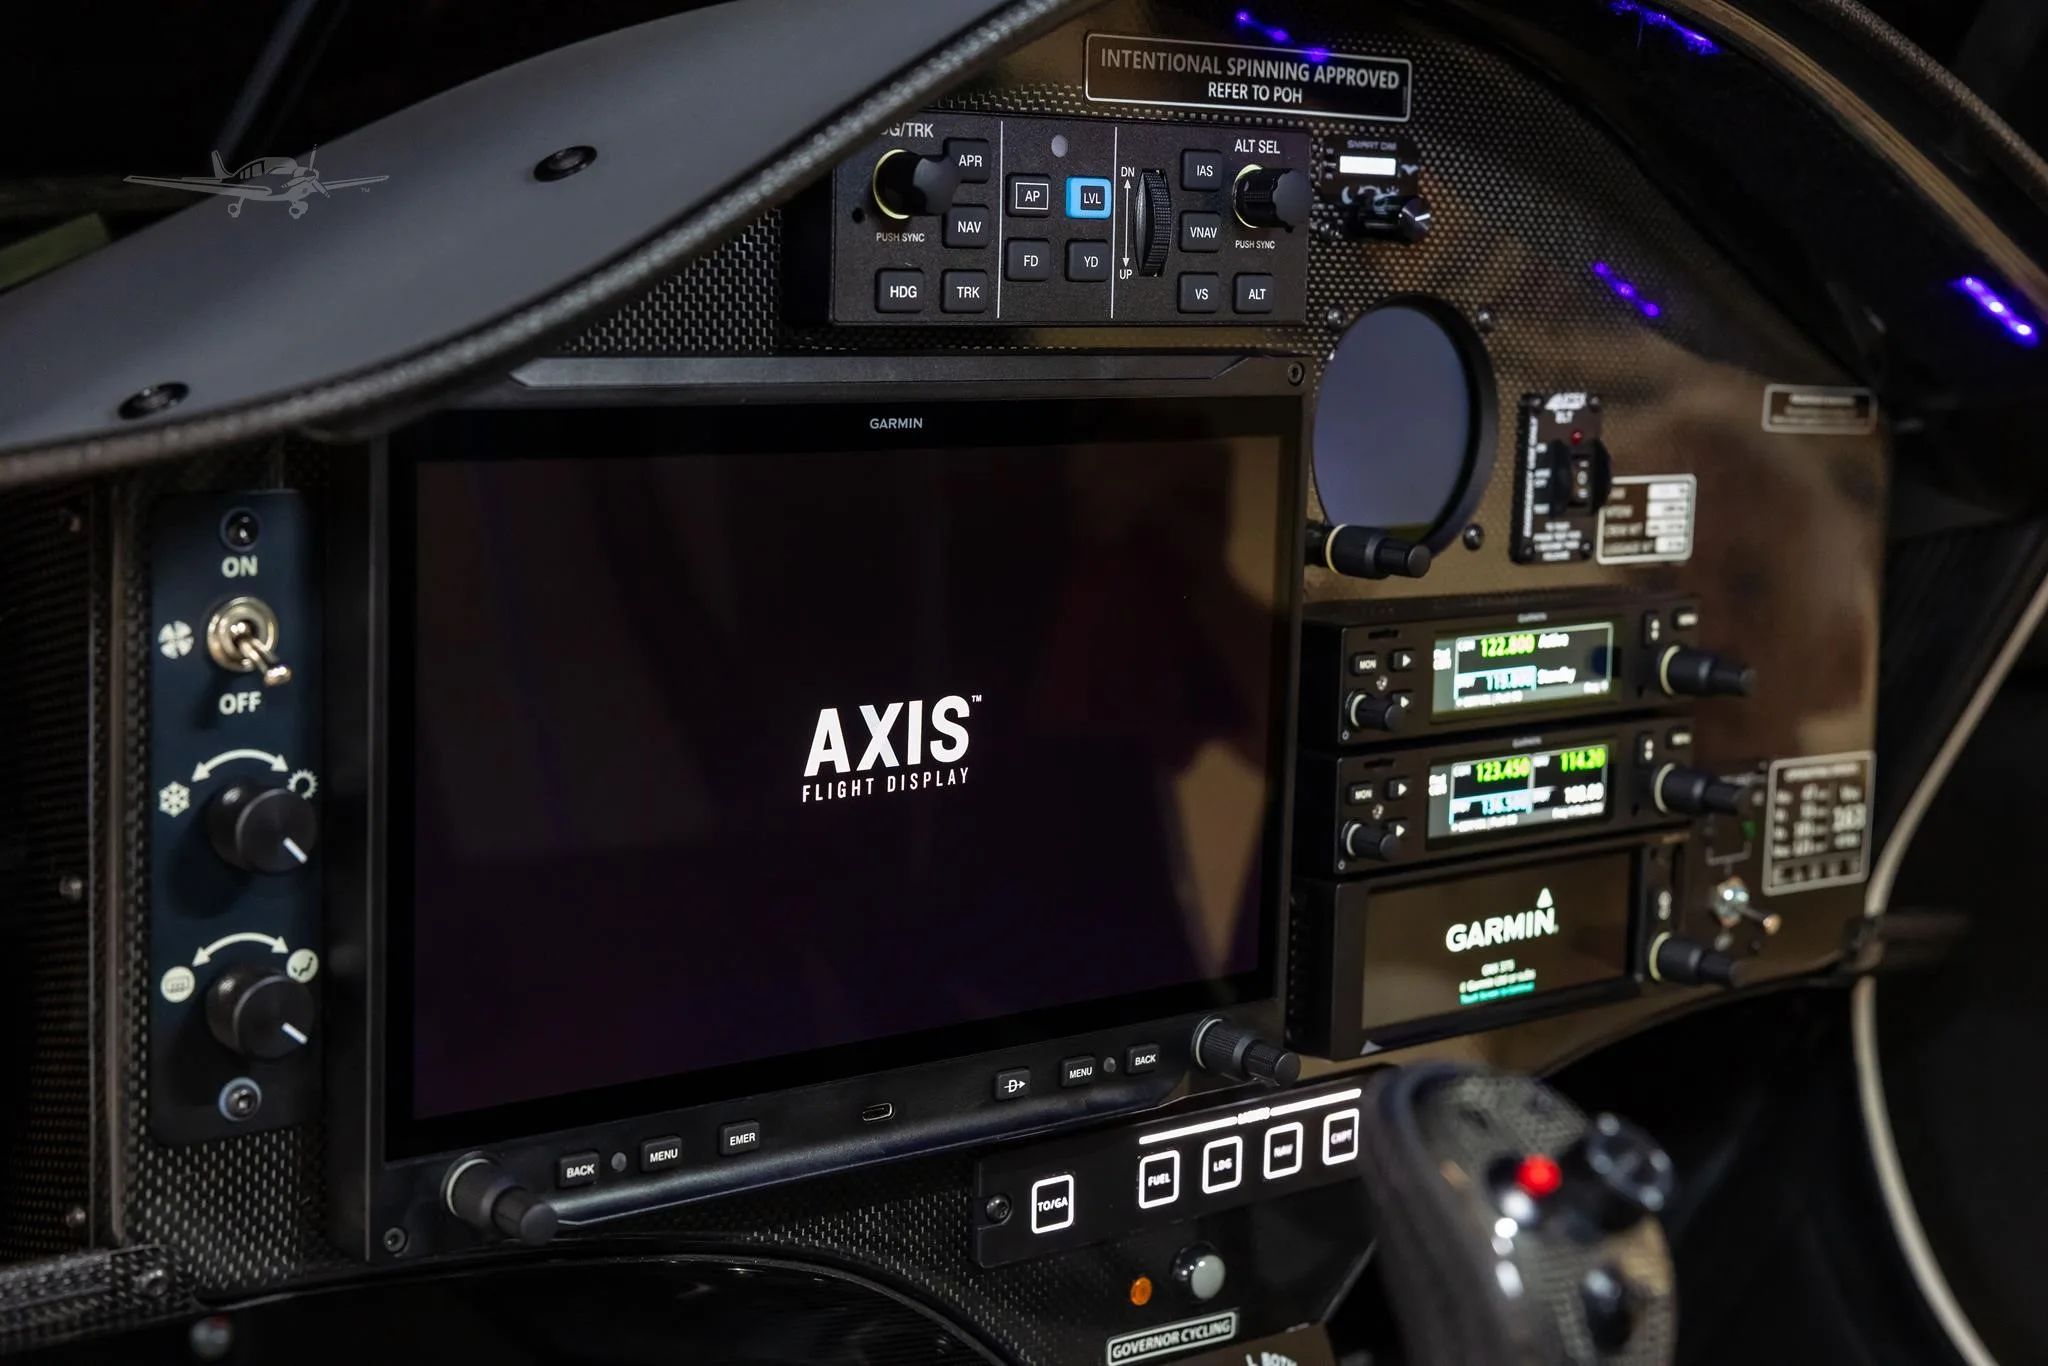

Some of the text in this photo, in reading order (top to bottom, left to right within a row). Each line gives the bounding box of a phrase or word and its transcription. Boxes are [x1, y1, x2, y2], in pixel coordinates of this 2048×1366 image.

[1101, 47, 1400, 89] INTENTIONAL SPINNING APPROVED
[1208, 82, 1303, 103] REFER TO POH
[880, 122, 934, 138] G/TRK
[1234, 139, 1281, 154] ALT SEL
[958, 155, 983, 168] APR
[1120, 167, 1135, 178] DN
[1196, 165, 1214, 177] IAS
[1025, 191, 1041, 202] AP
[1083, 192, 1102, 204] LVL
[957, 221, 982, 234] NAV
[1190, 226, 1217, 238] VNAV
[876, 232, 925, 243] PUSH SYNC
[1235, 239, 1276, 250] PUSH SYNC
[1023, 255, 1039, 267] FD
[1084, 256, 1099, 268] YD
[1119, 269, 1133, 280] UP
[889, 285, 918, 298] HDG
[956, 286, 980, 298] TRK
[1195, 288, 1209, 300] VS
[1248, 288, 1266, 300] ALT
[869, 417, 923, 429] GARMIN
[221, 555, 258, 578] ON
[219, 691, 262, 715] OFF
[802, 767, 969, 803] FLIGHT DISPLAY
[1134, 1054, 1156, 1066] BACK
[1069, 1066, 1093, 1079] MENU
[729, 1132, 756, 1147] EMER
[649, 1148, 679, 1163] MENU
[566, 1163, 595, 1178] BACK
[1147, 1172, 1171, 1188] FUEL
[1037, 1196, 1068, 1213] TO/GA
[1112, 1319, 1231, 1359] GOVERNOR CYCLING
